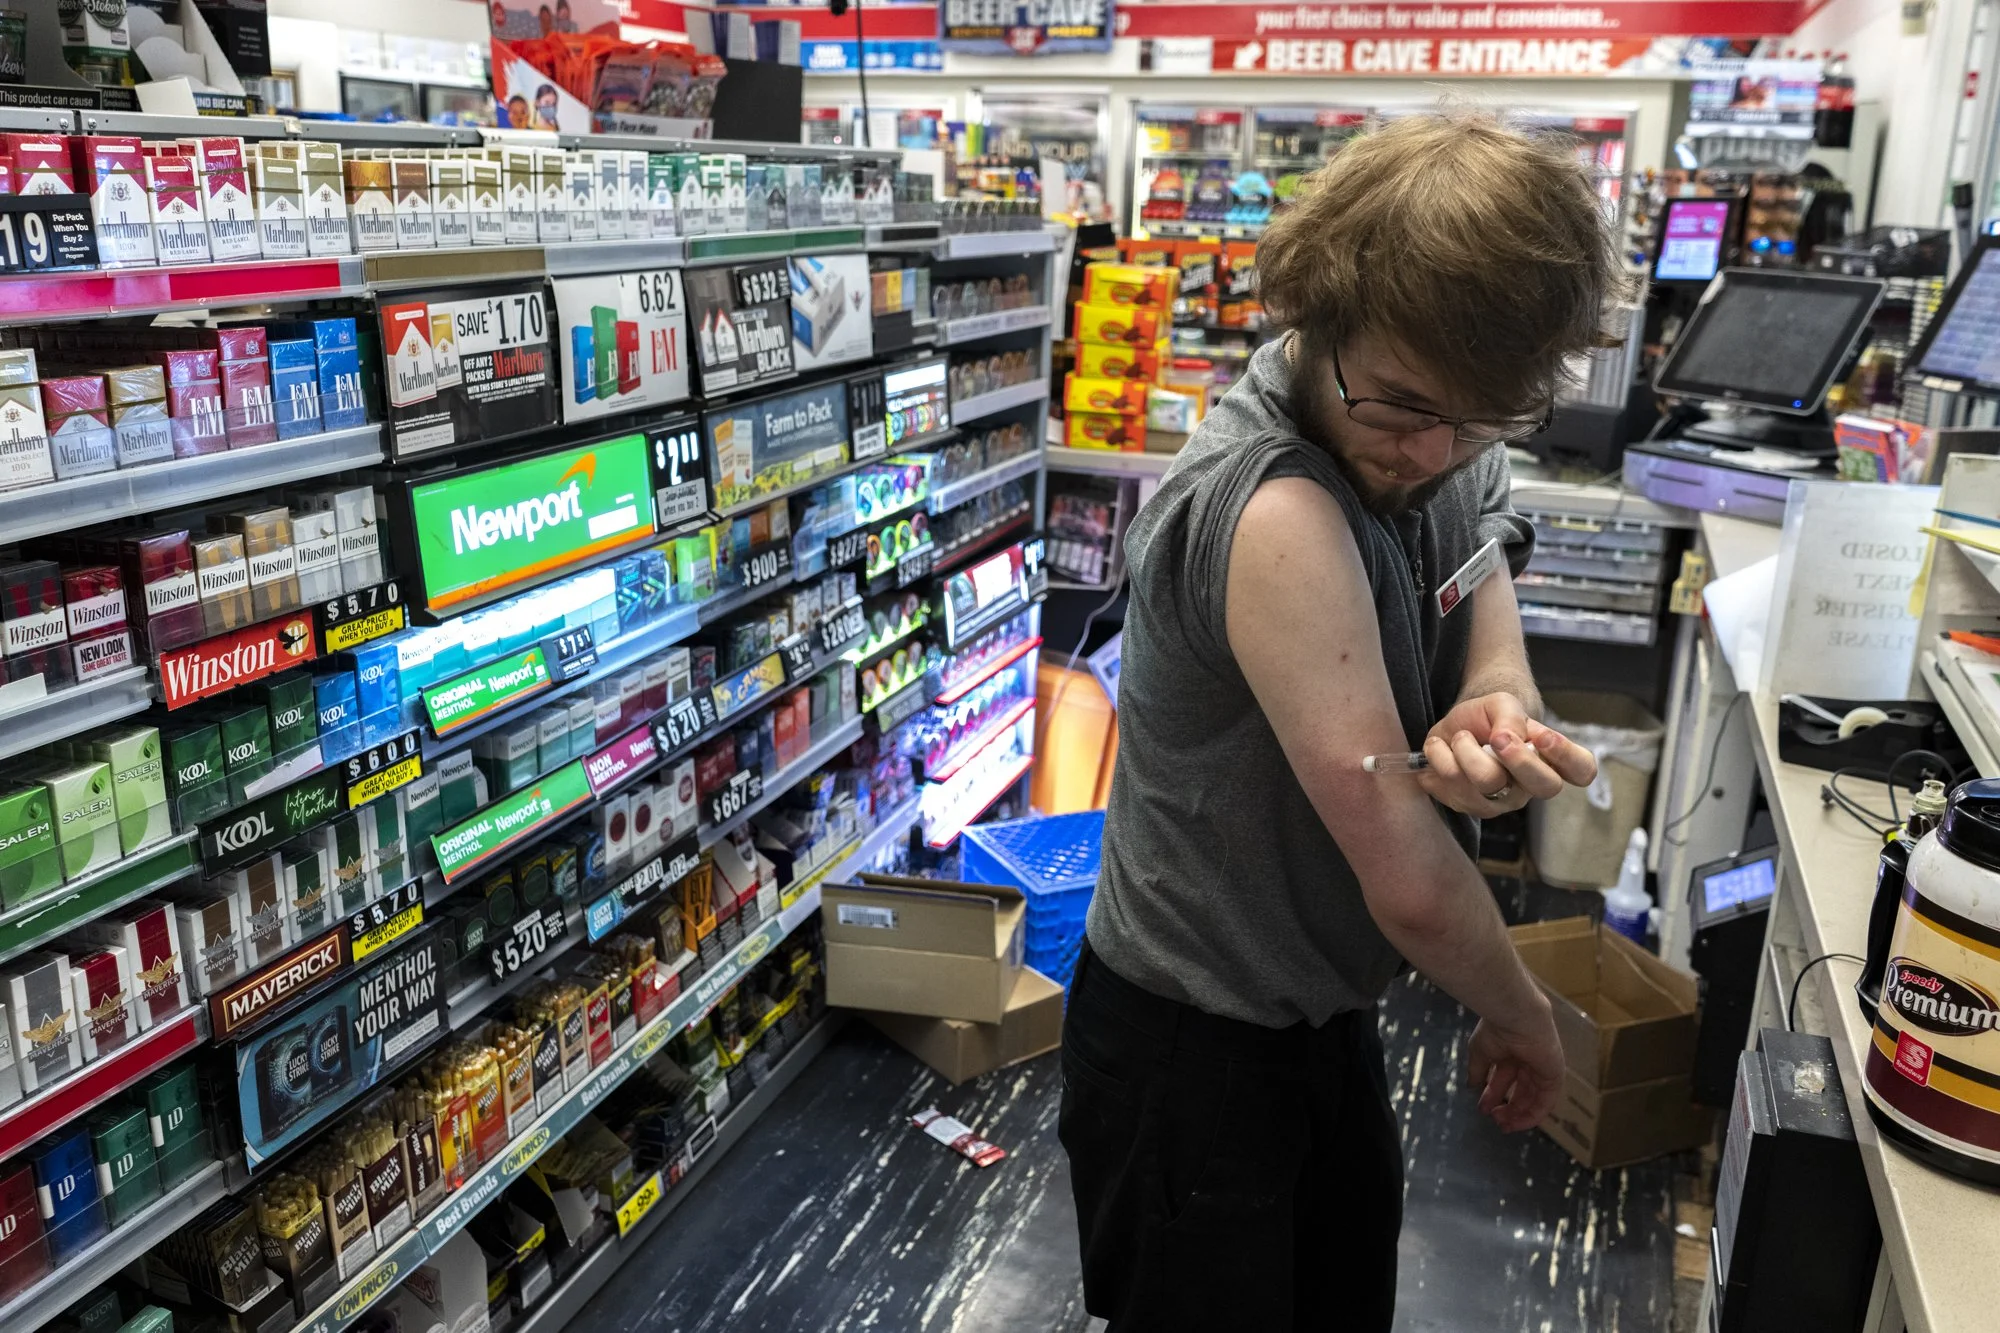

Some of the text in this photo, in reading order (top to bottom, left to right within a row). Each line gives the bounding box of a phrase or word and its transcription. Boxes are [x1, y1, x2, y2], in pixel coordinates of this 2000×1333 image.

[1257, 8, 1294, 34] your
[1298, 5, 1329, 28] first
[1332, 5, 1382, 28] choice
[1387, 5, 1410, 28] for
[1414, 5, 1456, 28] value
[1461, 5, 1492, 28] and
[1266, 39, 1612, 72] BEER CAVE ENTRANCE
[0, 91, 17, 104] This
[19, 92, 51, 106] product
[53, 96, 68, 105] can
[70, 97, 93, 107] cause
[52, 213, 84, 222] Per Pack
[53, 224, 89, 233] When You
[211, 208, 256, 238] Marlboro
[264, 217, 304, 243] Marlboro
[309, 208, 348, 234] Marlboro
[359, 208, 394, 234] Marlboro
[400, 211, 431, 235] Marlboro
[63, 235, 76, 243] Buy
[159, 220, 206, 249] Marlboro
[639, 272, 676, 314] 6.62
[458, 311, 489, 337] SAVE
[464, 346, 544, 379] OFF ANY 2 Marlboro
[757, 347, 792, 373] BLACK
[400, 361, 434, 393] Marlboro
[465, 369, 493, 383] PACKS OF
[467, 385, 480, 394] WITH
[480, 383, 490, 393] THIS
[289, 381, 320, 421] L&M
[335, 372, 364, 411] L&M
[190, 395, 224, 438] L&M
[241, 384, 274, 426] L&M
[765, 413, 793, 437] Farm
[794, 410, 806, 428] to
[807, 398, 833, 424] Pack
[121, 423, 168, 453] Marlboro
[59, 436, 110, 467] Marlboro
[450, 480, 582, 555] Newport
[299, 543, 336, 564] Winston
[341, 532, 377, 553] Winston
[202, 568, 245, 592] Winston
[252, 556, 293, 578] Winston
[149, 582, 195, 607] Winston
[73, 602, 120, 626] Winston
[341, 612, 389, 635] GREAT PRICE!
[9, 620, 63, 646] Winston
[338, 631, 358, 643] WHEN
[360, 625, 374, 636] YOU
[375, 620, 387, 631] BUY
[80, 637, 126, 665] NEW LOOK
[82, 651, 127, 673] SAME GREAT TASTE
[165, 638, 275, 701] Winston
[360, 665, 384, 683] KOOL
[488, 663, 534, 692] Newport
[275, 707, 304, 729] KOOL
[320, 705, 347, 726] KOOL
[434, 697, 476, 721] MENTHOL
[228, 740, 259, 764] KOOL
[511, 735, 535, 753] Newport
[117, 761, 160, 783] SALEM
[178, 759, 212, 785] KOOL
[364, 761, 412, 790] GREAT VALUE!
[441, 760, 471, 779] Newport
[589, 753, 612, 775] NON
[361, 768, 414, 799] WHEN YOU BUY 2
[410, 782, 438, 803] Newport
[62, 799, 111, 824] SALEM
[285, 786, 326, 815] Intense
[291, 790, 338, 826] Menthol
[495, 800, 539, 832] Newport
[0, 822, 49, 850] SALEM
[215, 811, 275, 857] KOOL
[439, 820, 493, 856] ORIGINAL
[443, 840, 483, 868] MENTHOL
[297, 904, 326, 922] MAVERICK
[367, 910, 413, 941] GREAT VALUE!
[251, 922, 283, 942] MAVERICK
[365, 937, 383, 950] WHEN
[384, 929, 397, 943] YOU
[398, 919, 411, 934] BUY
[205, 953, 238, 974] MAVERICK
[143, 976, 180, 1000] MAVERICK
[231, 945, 334, 1021] MAVERICK
[360, 946, 436, 1012] MENTHOL
[1899, 968, 1944, 993] Speedy
[355, 996, 400, 1044] YOUR
[404, 971, 437, 1012] WAY
[1884, 958, 2000, 1032] Premium
[90, 1011, 129, 1036] MAVERICK
[320, 1033, 339, 1053] LUCKY
[320, 1044, 340, 1063] STRIKE
[580, 1057, 630, 1107] Best Brands
[1895, 1058, 1925, 1082] Speedway
[504, 1129, 548, 1174] LOW PRICES!
[370, 1156, 398, 1194] Black
[380, 1167, 401, 1197] Mild
[435, 1173, 499, 1236] Best Brands
[220, 1234, 256, 1276] Black
[234, 1243, 262, 1279] Mild
[337, 1261, 396, 1319] LOW PRICES!
[85, 1300, 114, 1325] NJOY
